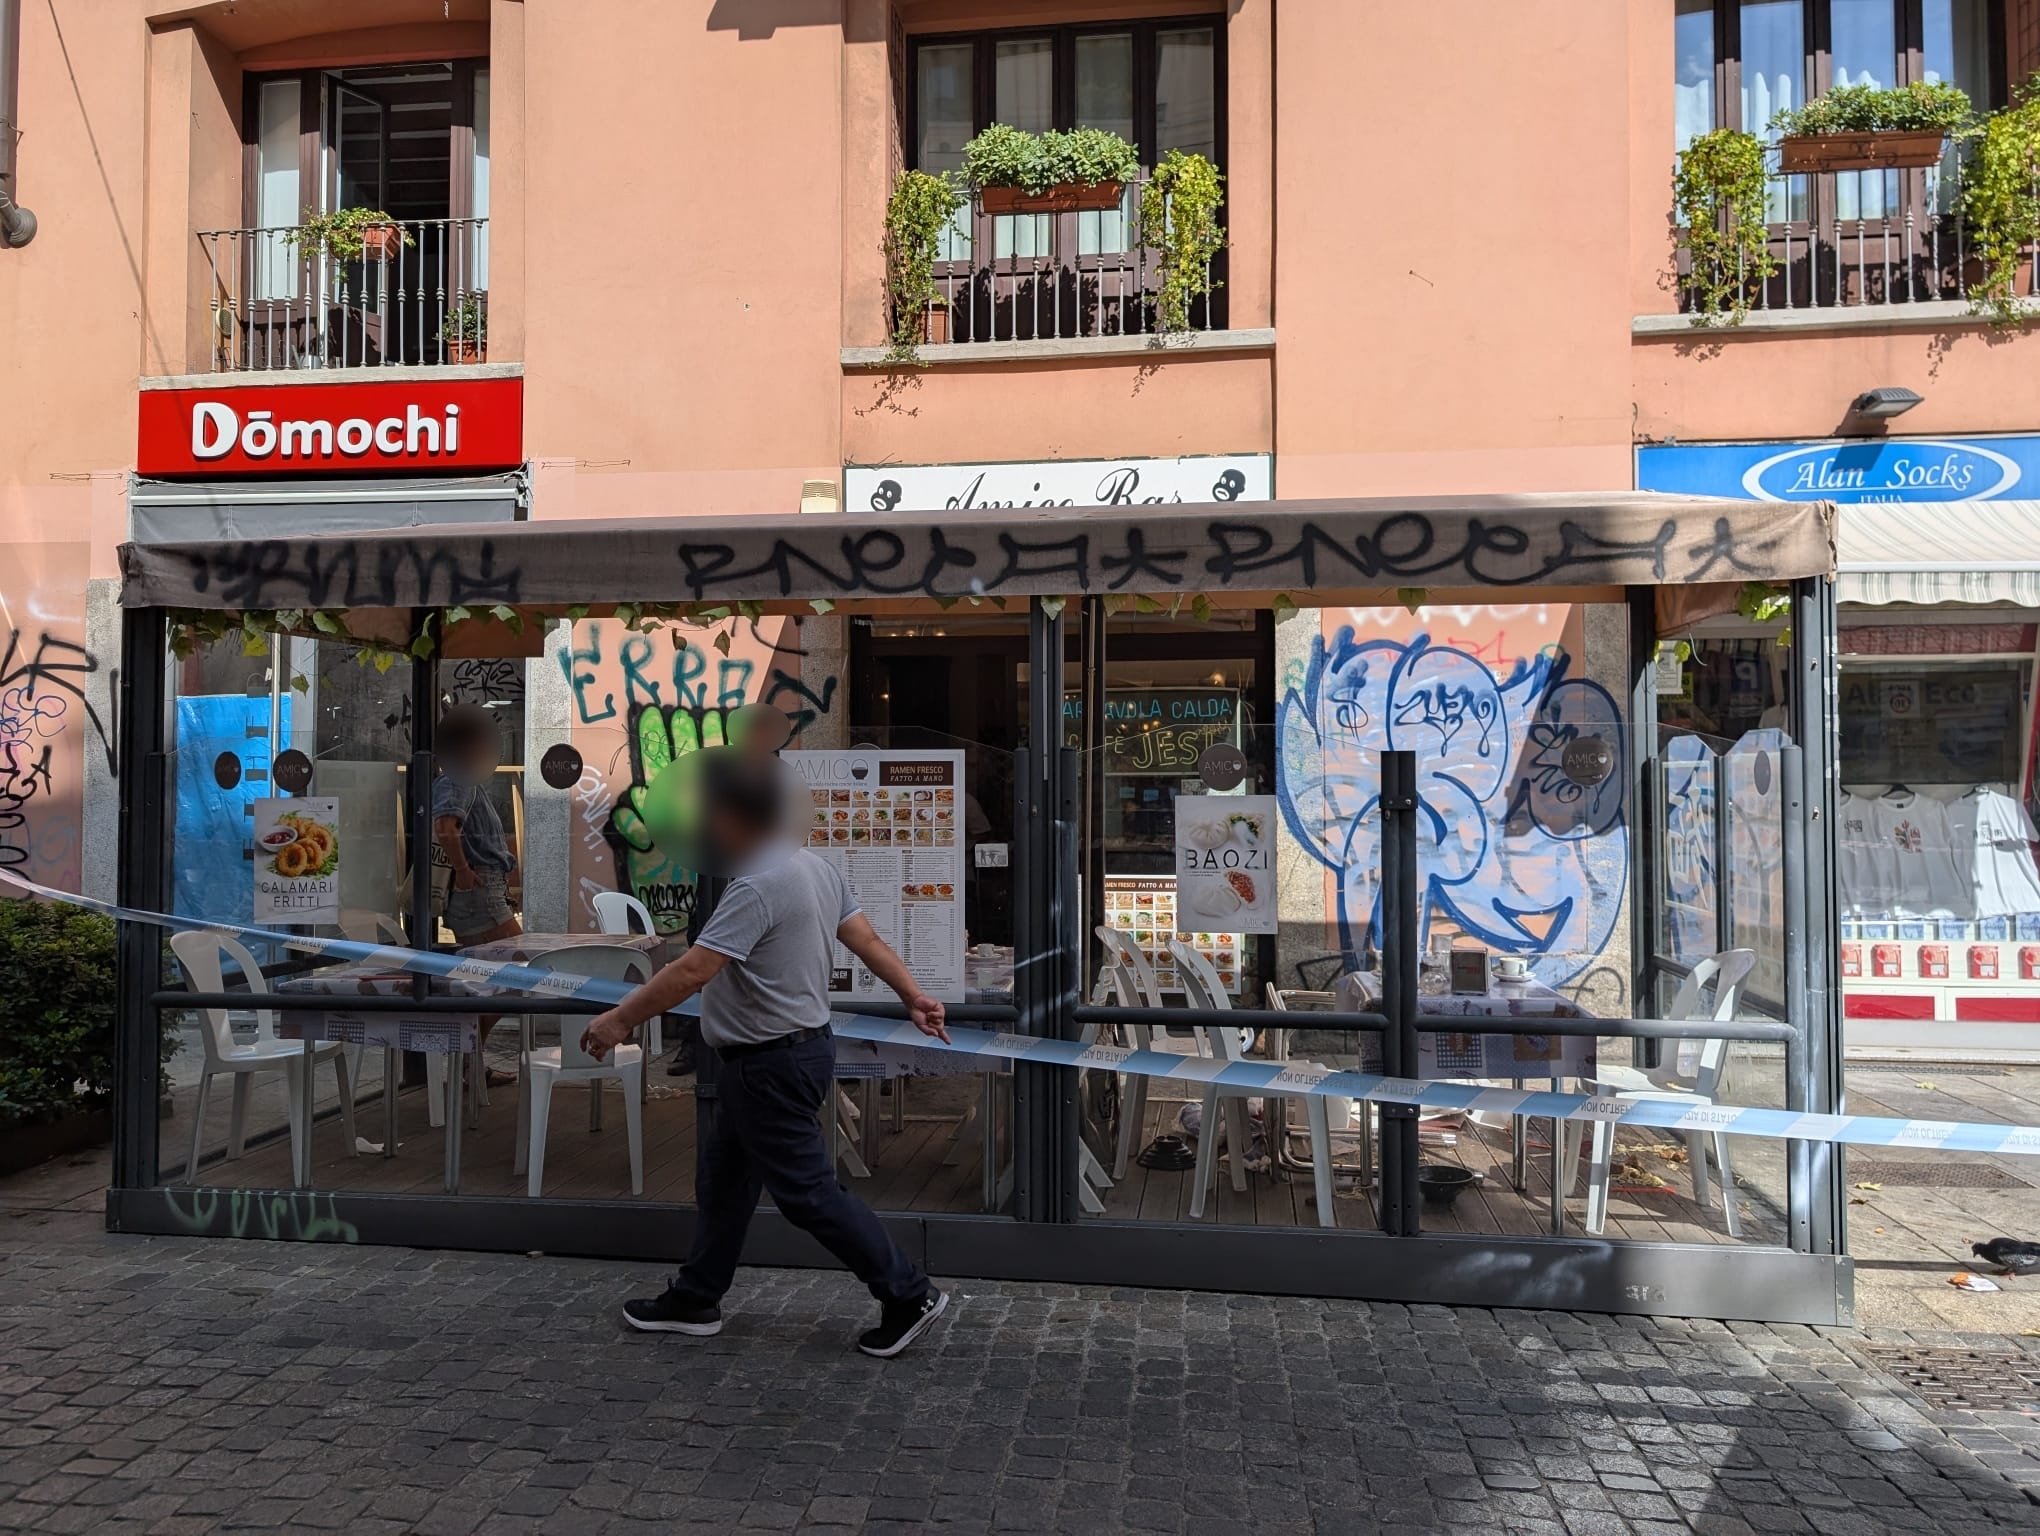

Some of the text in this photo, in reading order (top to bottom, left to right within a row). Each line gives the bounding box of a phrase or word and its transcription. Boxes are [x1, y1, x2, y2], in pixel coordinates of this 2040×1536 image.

[191, 401, 460, 460] Dōmochi
[1786, 453, 1974, 493] Alan Socks
[1104, 698, 1162, 719] AVOLA
[1171, 696, 1233, 719] CALDA
[889, 765, 945, 775] RAMEN FRESCO
[889, 775, 914, 783] FATTO
[923, 775, 945, 783] MANO
[1184, 848, 1268, 870] BAOZI
[261, 881, 333, 894] CALAMARI
[273, 895, 320, 908] FRITTI
